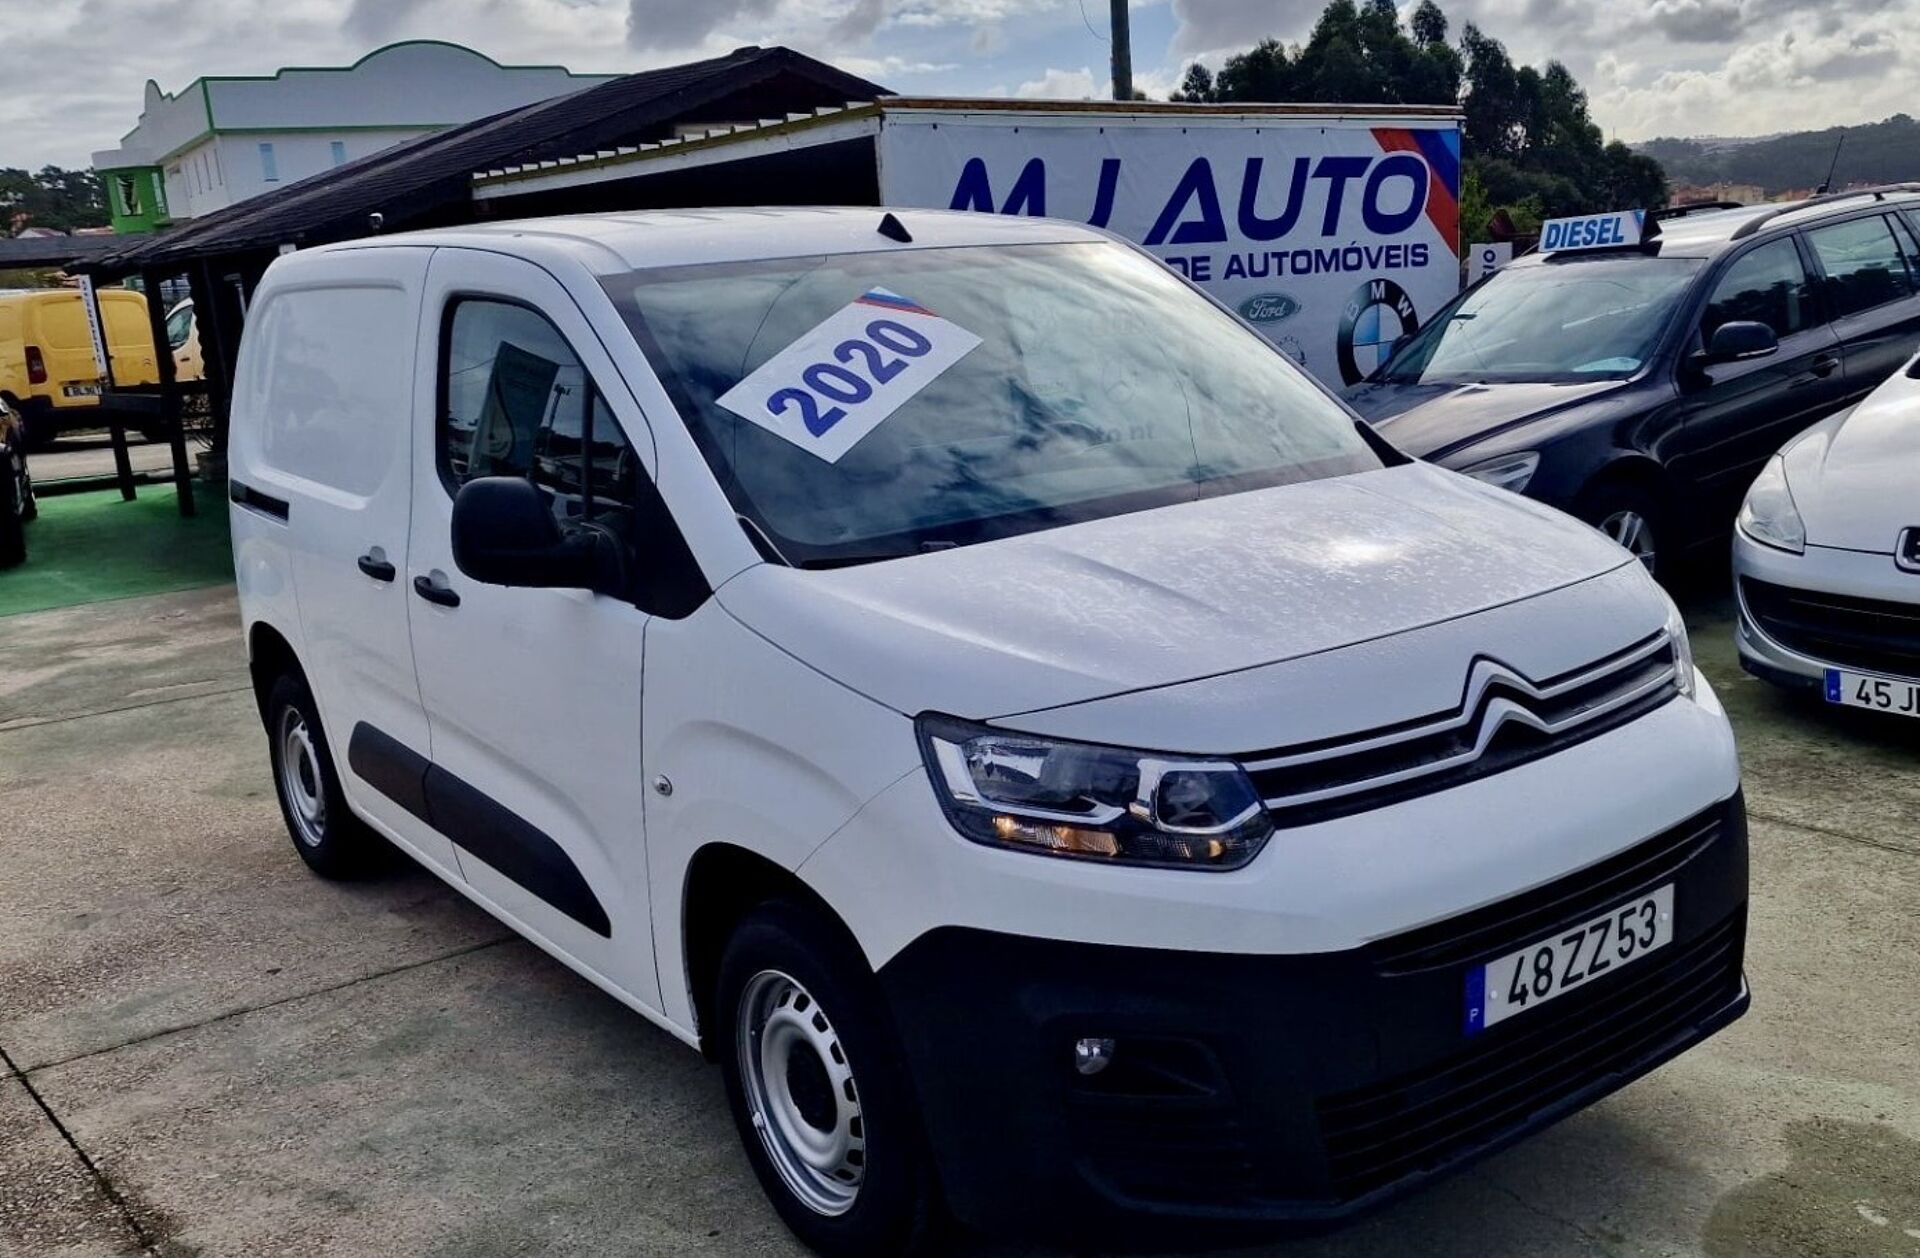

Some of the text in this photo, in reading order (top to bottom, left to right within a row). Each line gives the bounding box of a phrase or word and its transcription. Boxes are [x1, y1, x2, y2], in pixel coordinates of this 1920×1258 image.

[1142, 156, 1427, 246] AUTO
[1544, 217, 1624, 249] DIESEL
[1223, 242, 1429, 280] AUTOMÓVEIS
[1249, 298, 1286, 319] Ford
[767, 319, 932, 438] 2020
[1856, 679, 1892, 708] 45
[1508, 899, 1657, 1006] 48ZZ53
